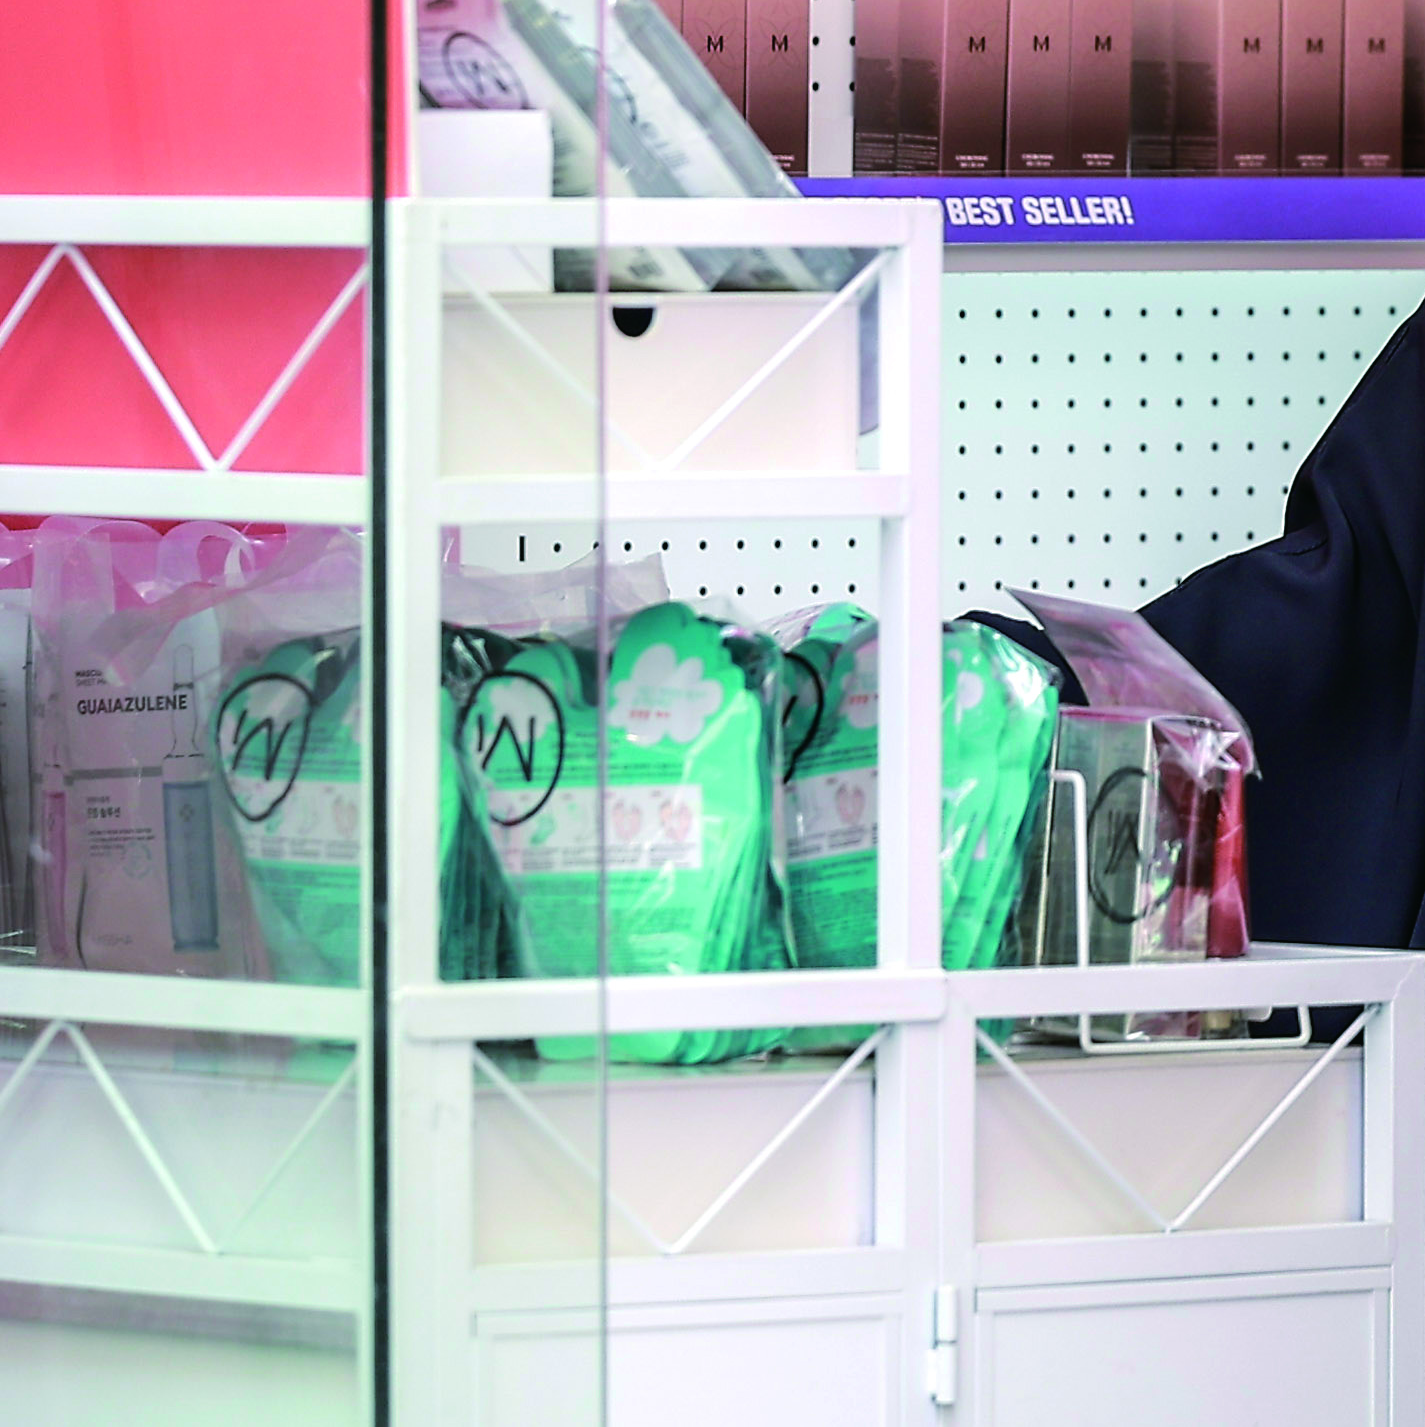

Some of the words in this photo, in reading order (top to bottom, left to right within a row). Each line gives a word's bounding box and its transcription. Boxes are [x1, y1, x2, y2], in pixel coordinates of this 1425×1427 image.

[707, 35, 723, 53] M
[772, 34, 788, 52] M
[969, 35, 985, 53] M
[1033, 35, 1049, 52] M
[1095, 35, 1112, 52] M
[945, 196, 1014, 226] BEST
[1021, 195, 1135, 226] SELLER!
[77, 694, 188, 715] GUAIAZULENE
